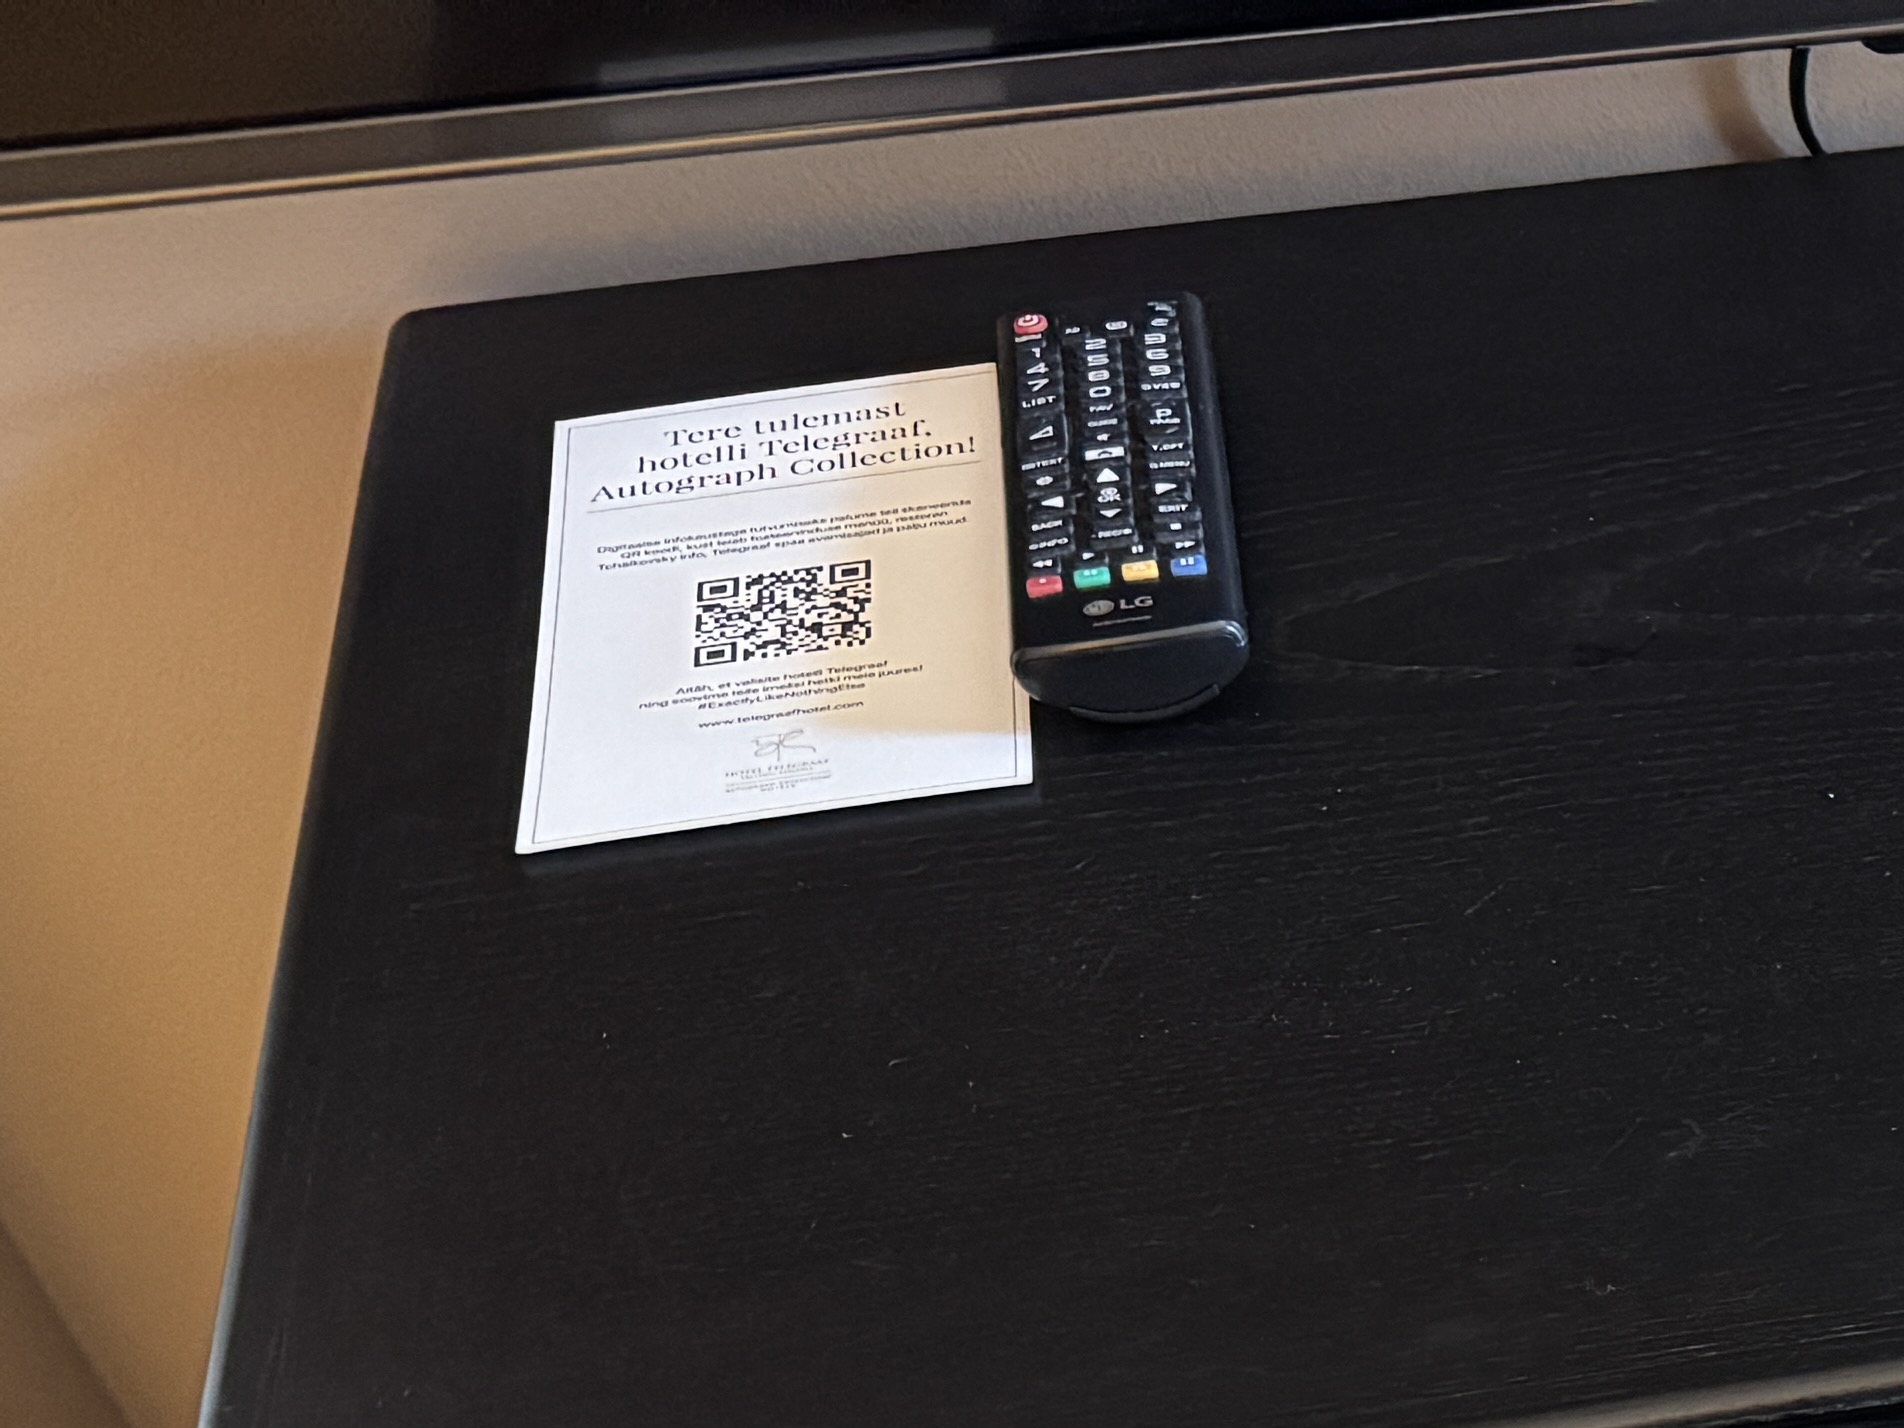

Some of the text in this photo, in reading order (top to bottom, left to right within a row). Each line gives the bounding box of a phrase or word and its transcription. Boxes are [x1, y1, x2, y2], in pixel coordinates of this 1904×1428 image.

[1027, 362, 1049, 375] 4
[1087, 353, 1109, 366] 5
[1089, 386, 1112, 398] 0
[1156, 408, 1172, 419] P
[664, 402, 906, 448] Tere tulemast
[591, 436, 976, 503] Autograph Collection!
[638, 444, 747, 474] hotelli
[1119, 595, 1154, 610] LG
